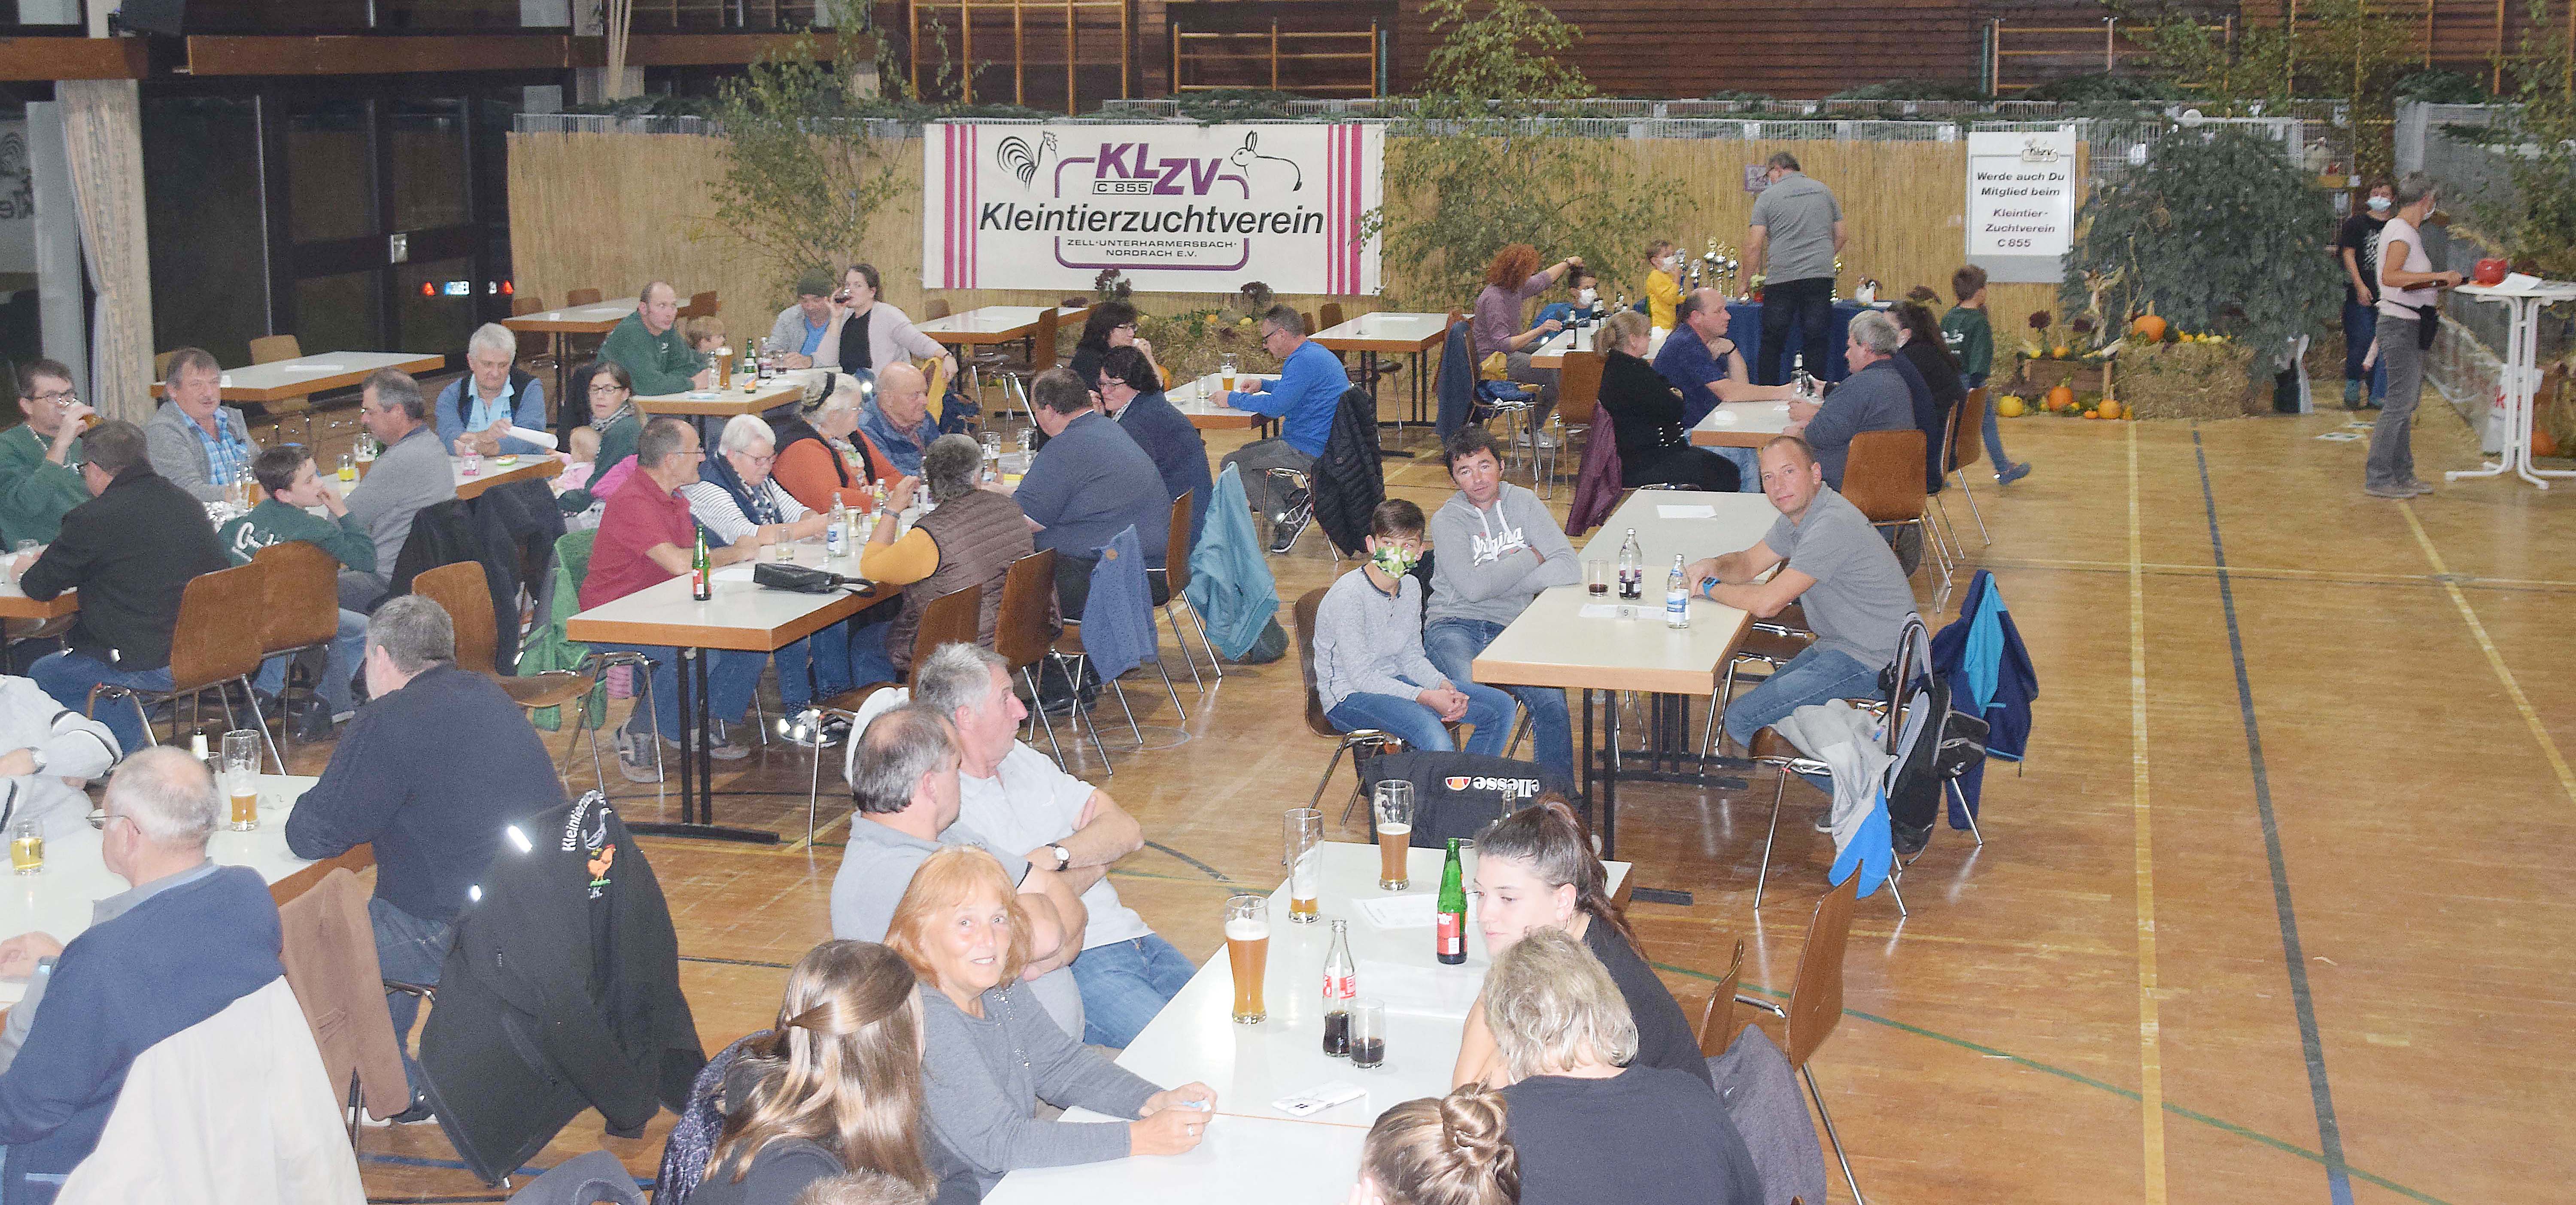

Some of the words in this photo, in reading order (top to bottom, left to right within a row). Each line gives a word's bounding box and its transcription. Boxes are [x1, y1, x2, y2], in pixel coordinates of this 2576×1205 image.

[1096, 143, 1223, 195] KLZV
[1978, 172, 2012, 181] Werde
[2016, 172, 2044, 180] auch
[2048, 172, 2065, 180] Du
[1097, 183, 1107, 192] C
[1115, 183, 1148, 192] 855
[1981, 187, 2027, 197] Mitglied
[2031, 187, 2060, 196] beim
[1993, 209, 2048, 217] Kleintier-
[979, 202, 1324, 234] Kleintierzuchtverein
[1985, 223, 2055, 232] Zuchtverein
[1998, 238, 2005, 247] C
[2008, 238, 2032, 247] 855
[1473, 776, 1540, 797] ellesse
